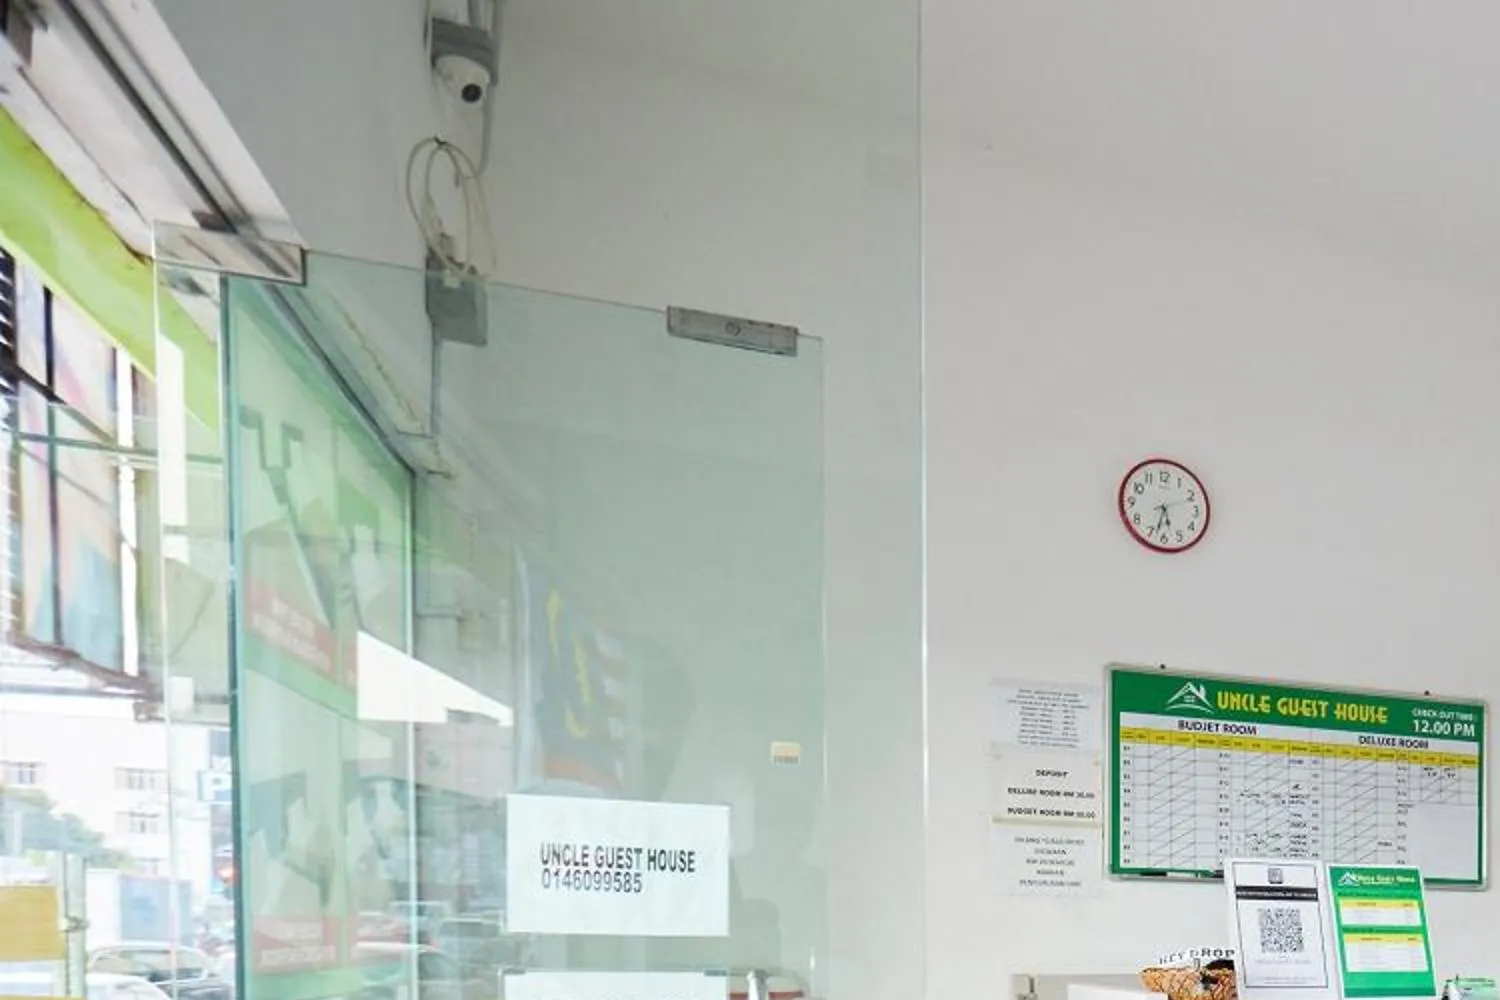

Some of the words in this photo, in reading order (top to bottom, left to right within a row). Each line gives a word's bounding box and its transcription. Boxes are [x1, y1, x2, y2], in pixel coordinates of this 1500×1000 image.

[1159, 471, 1171, 483] 12
[1133, 482, 1145, 495] 10
[1127, 496, 1136, 508] 9
[1187, 489, 1195, 502] 2
[1193, 505, 1199, 518] 3
[1133, 513, 1141, 525] 8
[1147, 526, 1155, 537] 7
[1187, 521, 1195, 531] 4
[1160, 533, 1168, 544] 6
[1176, 530, 1183, 542] 5
[1217, 691, 1270, 713] UNCLE
[1277, 697, 1328, 718] GUEST
[1334, 703, 1389, 724] HOUSE
[1178, 719, 1219, 733] BUDJET
[1223, 723, 1257, 736] ROOM
[1413, 719, 1450, 735] 12.00
[1454, 722, 1475, 737] PM
[1359, 735, 1397, 747] DELUXE
[1399, 738, 1429, 749] ROOM
[540, 842, 590, 868] UNCLE
[594, 845, 643, 870] GUEST
[647, 849, 696, 873] HOUSE
[541, 869, 643, 894] 0146099585
